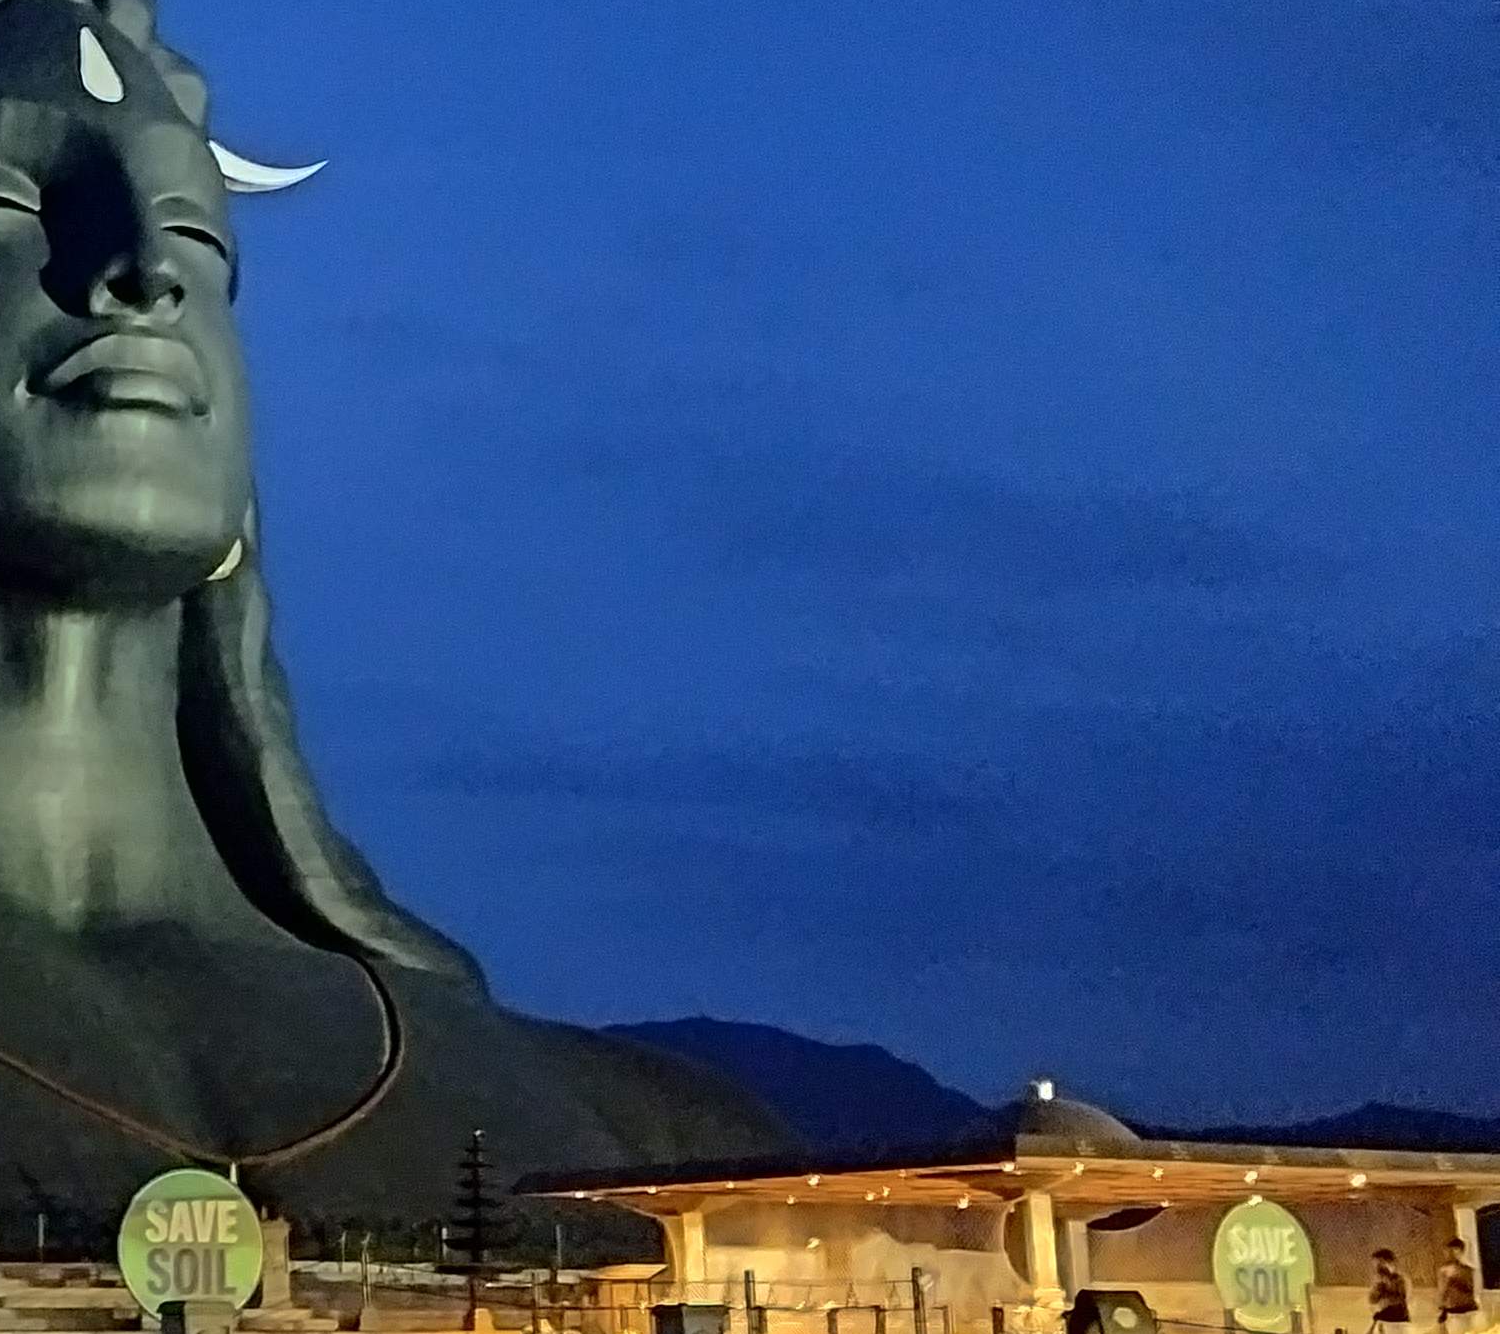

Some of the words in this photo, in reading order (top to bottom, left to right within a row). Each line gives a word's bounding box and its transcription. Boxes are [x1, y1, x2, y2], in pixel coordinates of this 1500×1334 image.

[145, 1200, 238, 1244] SAVE
[1227, 1223, 1298, 1266] SAVE
[147, 1247, 237, 1296] SOIL
[1235, 1267, 1293, 1307] SOIL
